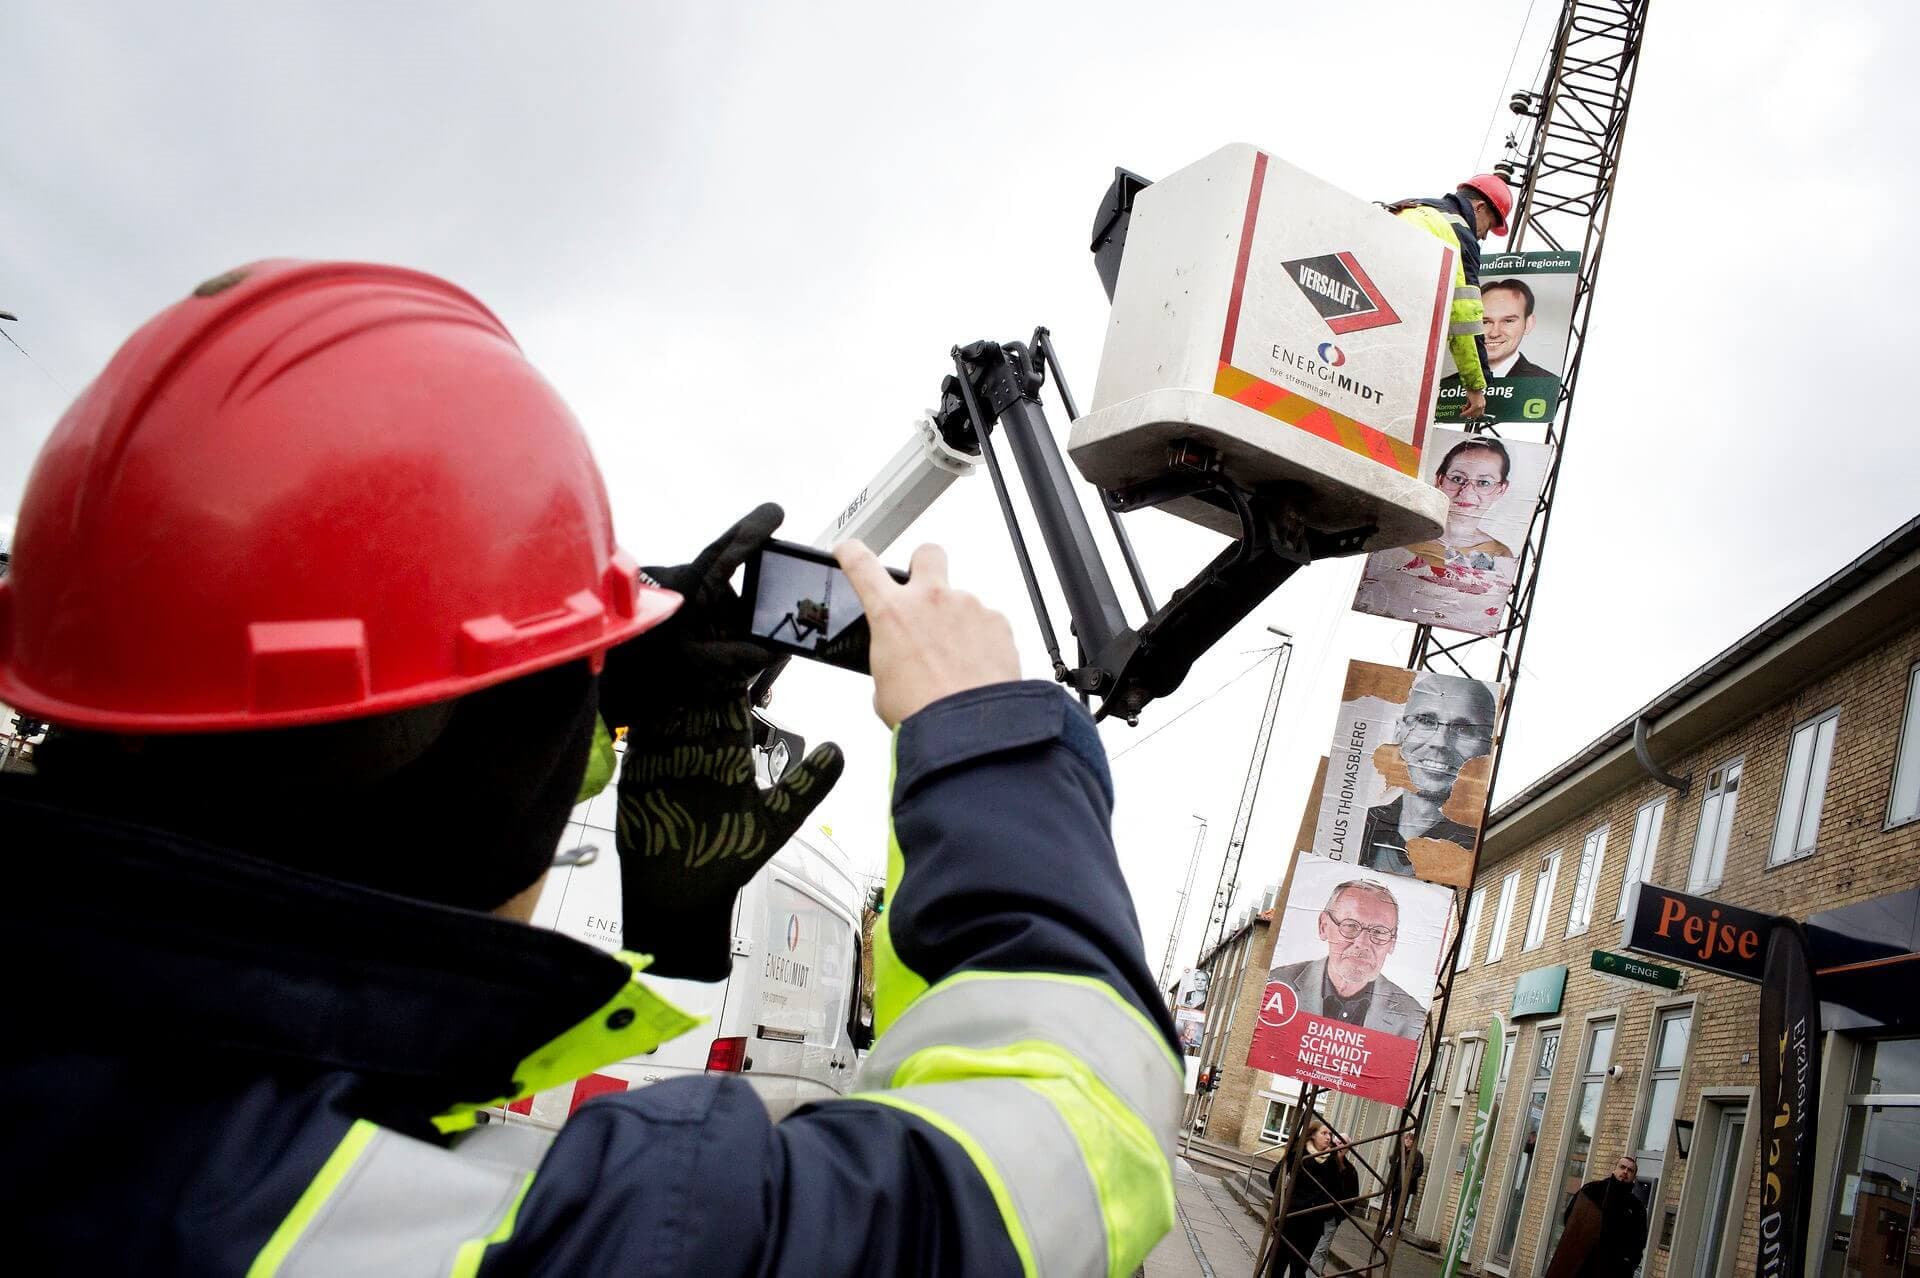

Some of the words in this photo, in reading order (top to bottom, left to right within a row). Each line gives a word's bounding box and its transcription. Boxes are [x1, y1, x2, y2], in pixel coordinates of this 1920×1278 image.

[1527, 258, 1571, 268] regionen
[1300, 264, 1359, 310] VERSALIFT
[1269, 367, 1283, 376] nye
[1285, 373, 1331, 398] strømninger
[1439, 385, 1467, 398] cola
[1329, 820, 1348, 861] CLAUS
[1343, 721, 1367, 817] THOMASBJERG
[587, 916, 621, 934] ENE
[1655, 896, 1759, 960] Pejse
[1625, 963, 1659, 980] PENGE
[1265, 993, 1284, 1014] A
[1308, 1021, 1367, 1048] BJARNE
[1300, 1035, 1372, 1064] SCHMIDT
[1297, 1051, 1363, 1077] NIELSEN
